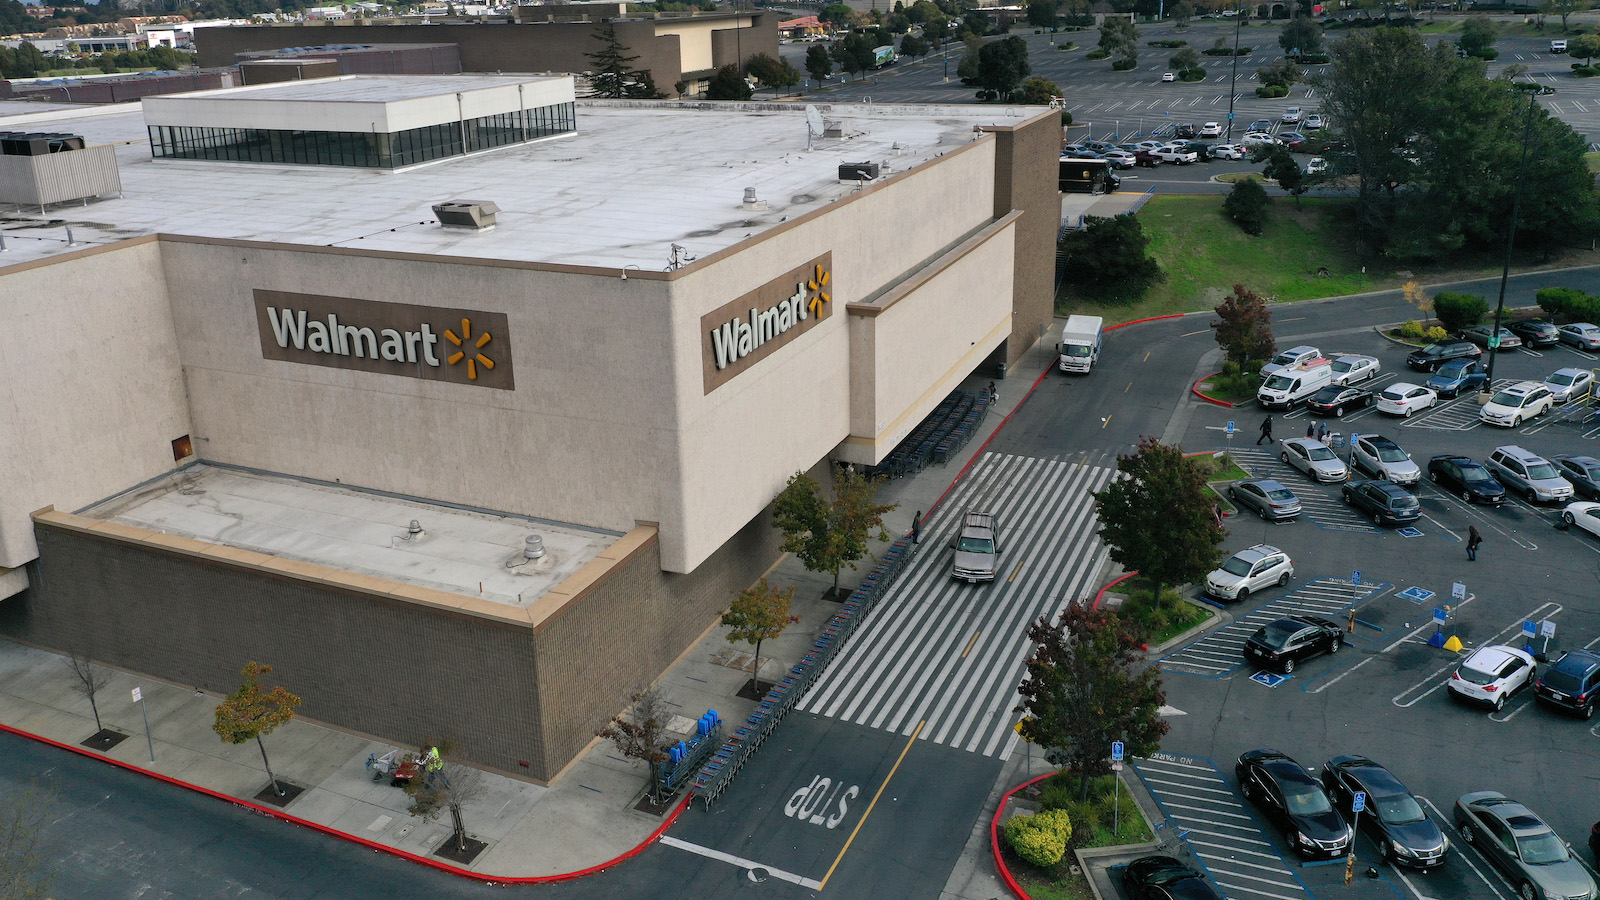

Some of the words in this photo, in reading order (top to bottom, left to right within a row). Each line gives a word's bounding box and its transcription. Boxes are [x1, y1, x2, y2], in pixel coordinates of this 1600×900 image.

[267, 306, 440, 367] Walmart
[712, 282, 807, 370] Walmart
[1180, 756, 1193, 764] NO
[784, 774, 859, 829] STOP
